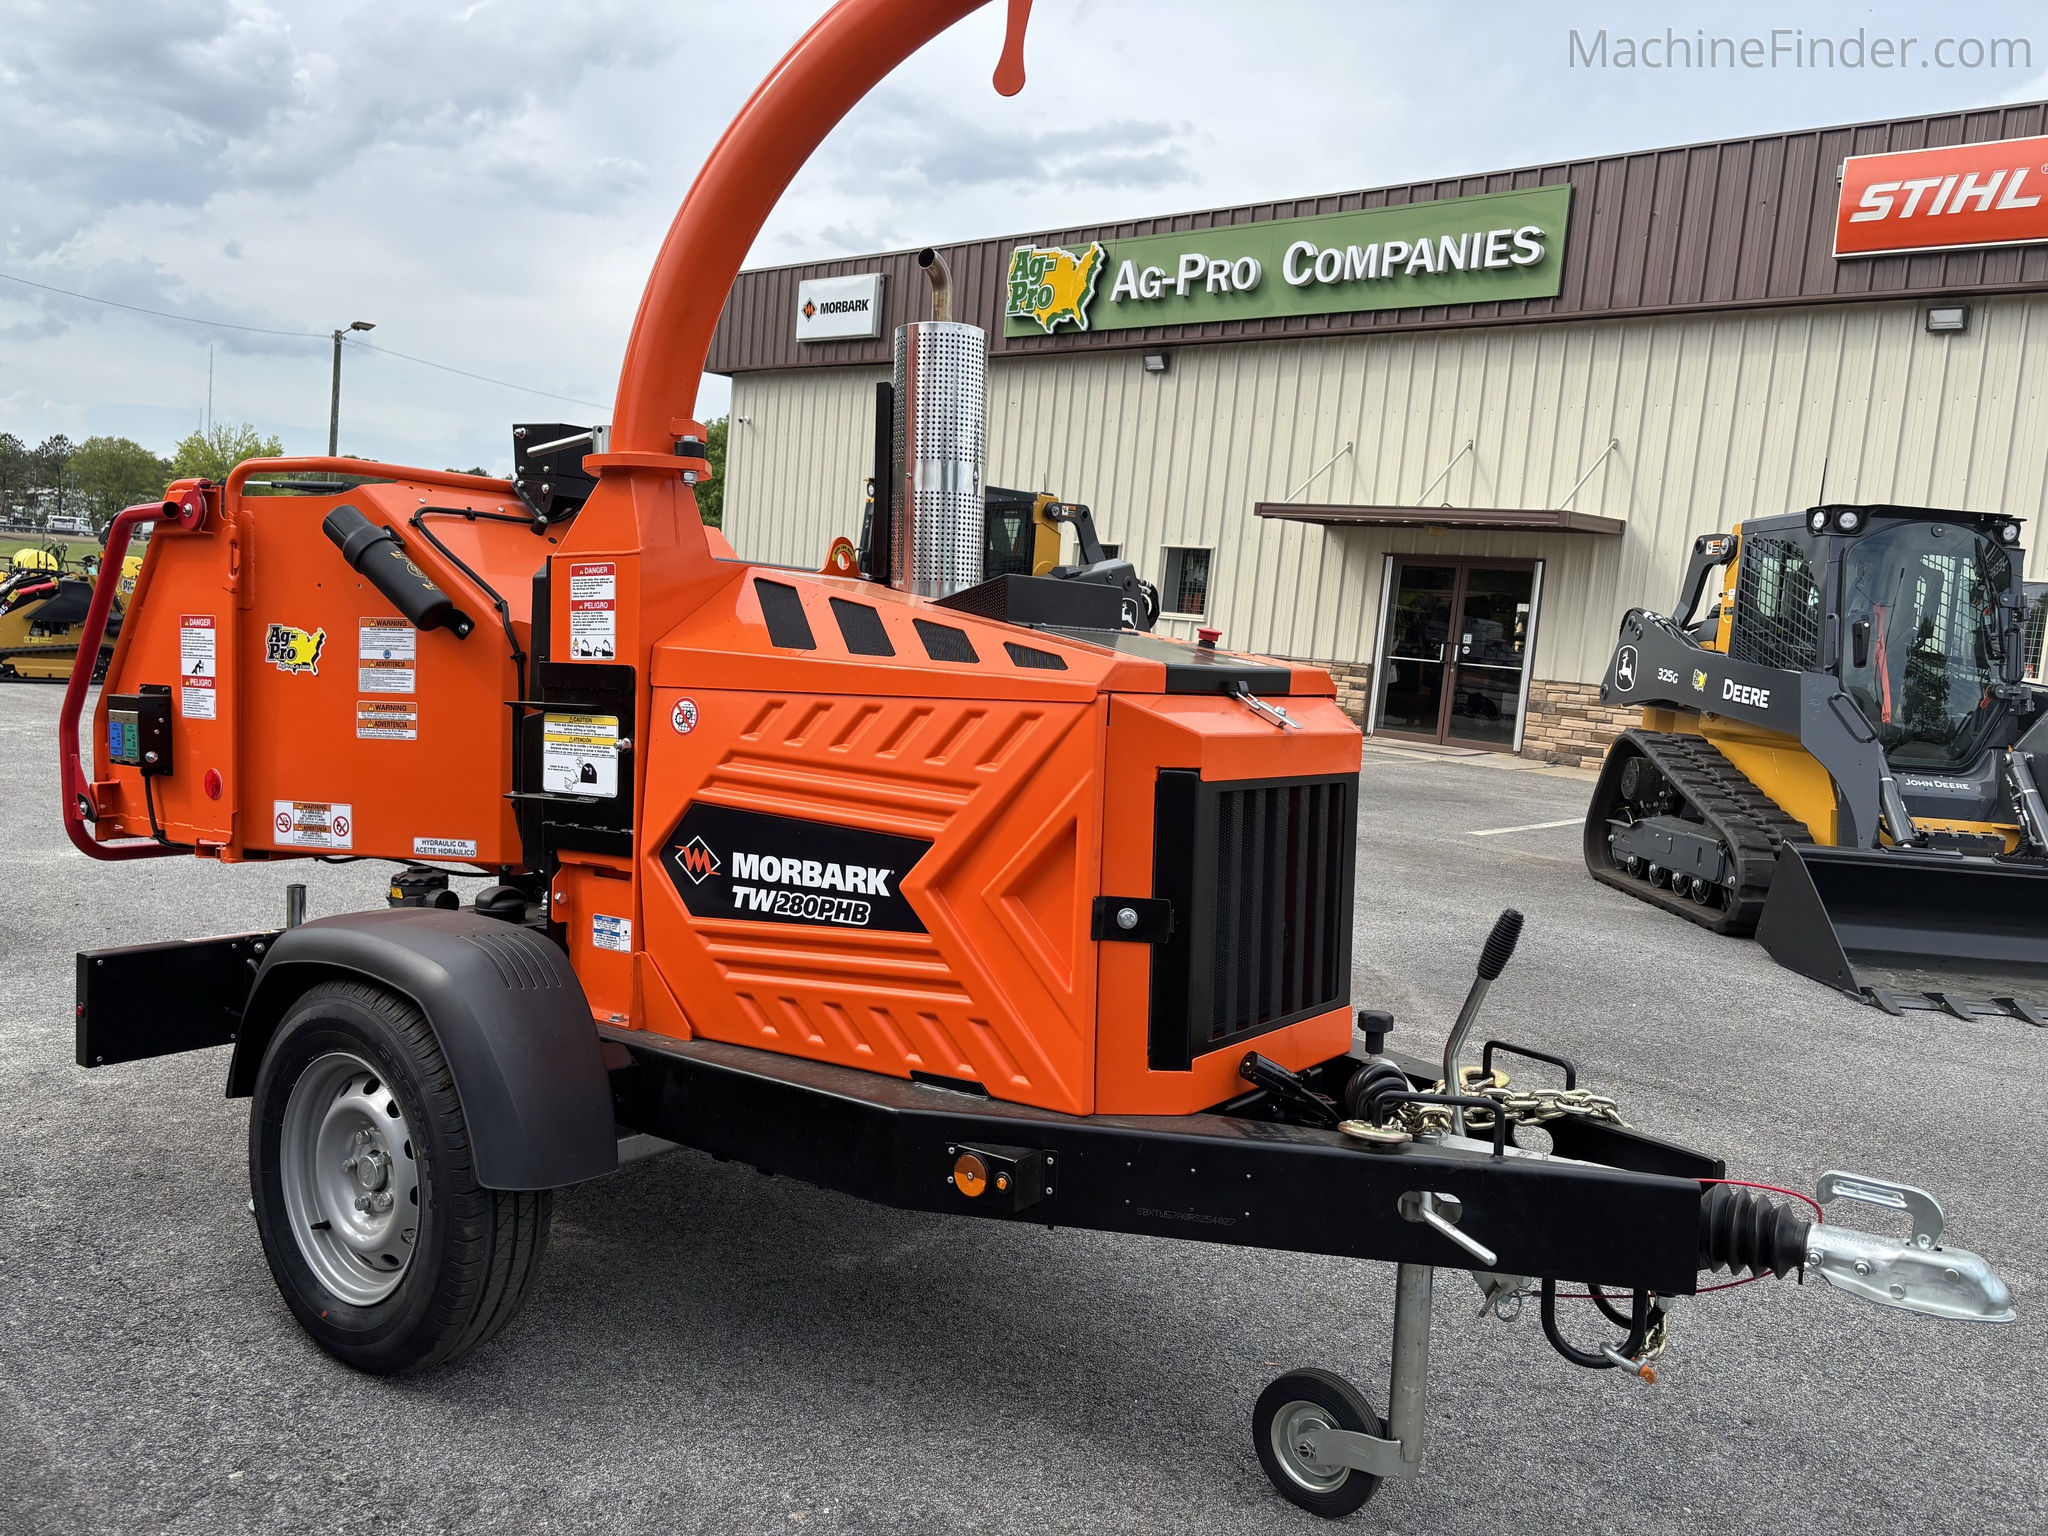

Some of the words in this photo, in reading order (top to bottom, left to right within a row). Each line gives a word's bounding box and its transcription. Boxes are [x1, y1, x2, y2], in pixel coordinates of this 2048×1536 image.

[1849, 167, 2041, 223] STIHL
[1010, 248, 1057, 286] Ag-
[1007, 281, 1055, 314] Pro
[820, 299, 869, 315] MORBARK
[584, 566, 608, 574] DANGER
[190, 618, 211, 626] DANGER
[269, 626, 297, 646] Ag-
[268, 644, 297, 660] Pro
[376, 660, 406, 668] ADVERTENCIA
[190, 678, 212, 687] PELIGRO
[1657, 667, 1679, 685] 325G
[1722, 678, 1771, 709] DEERE
[374, 720, 408, 728] ADVERTENCIA
[1905, 778, 1934, 788] JOHN
[1934, 780, 1970, 790] DEERE
[416, 846, 437, 854] ACEITE
[732, 851, 891, 897] MORBARK
[731, 885, 871, 925] TW280PHB
